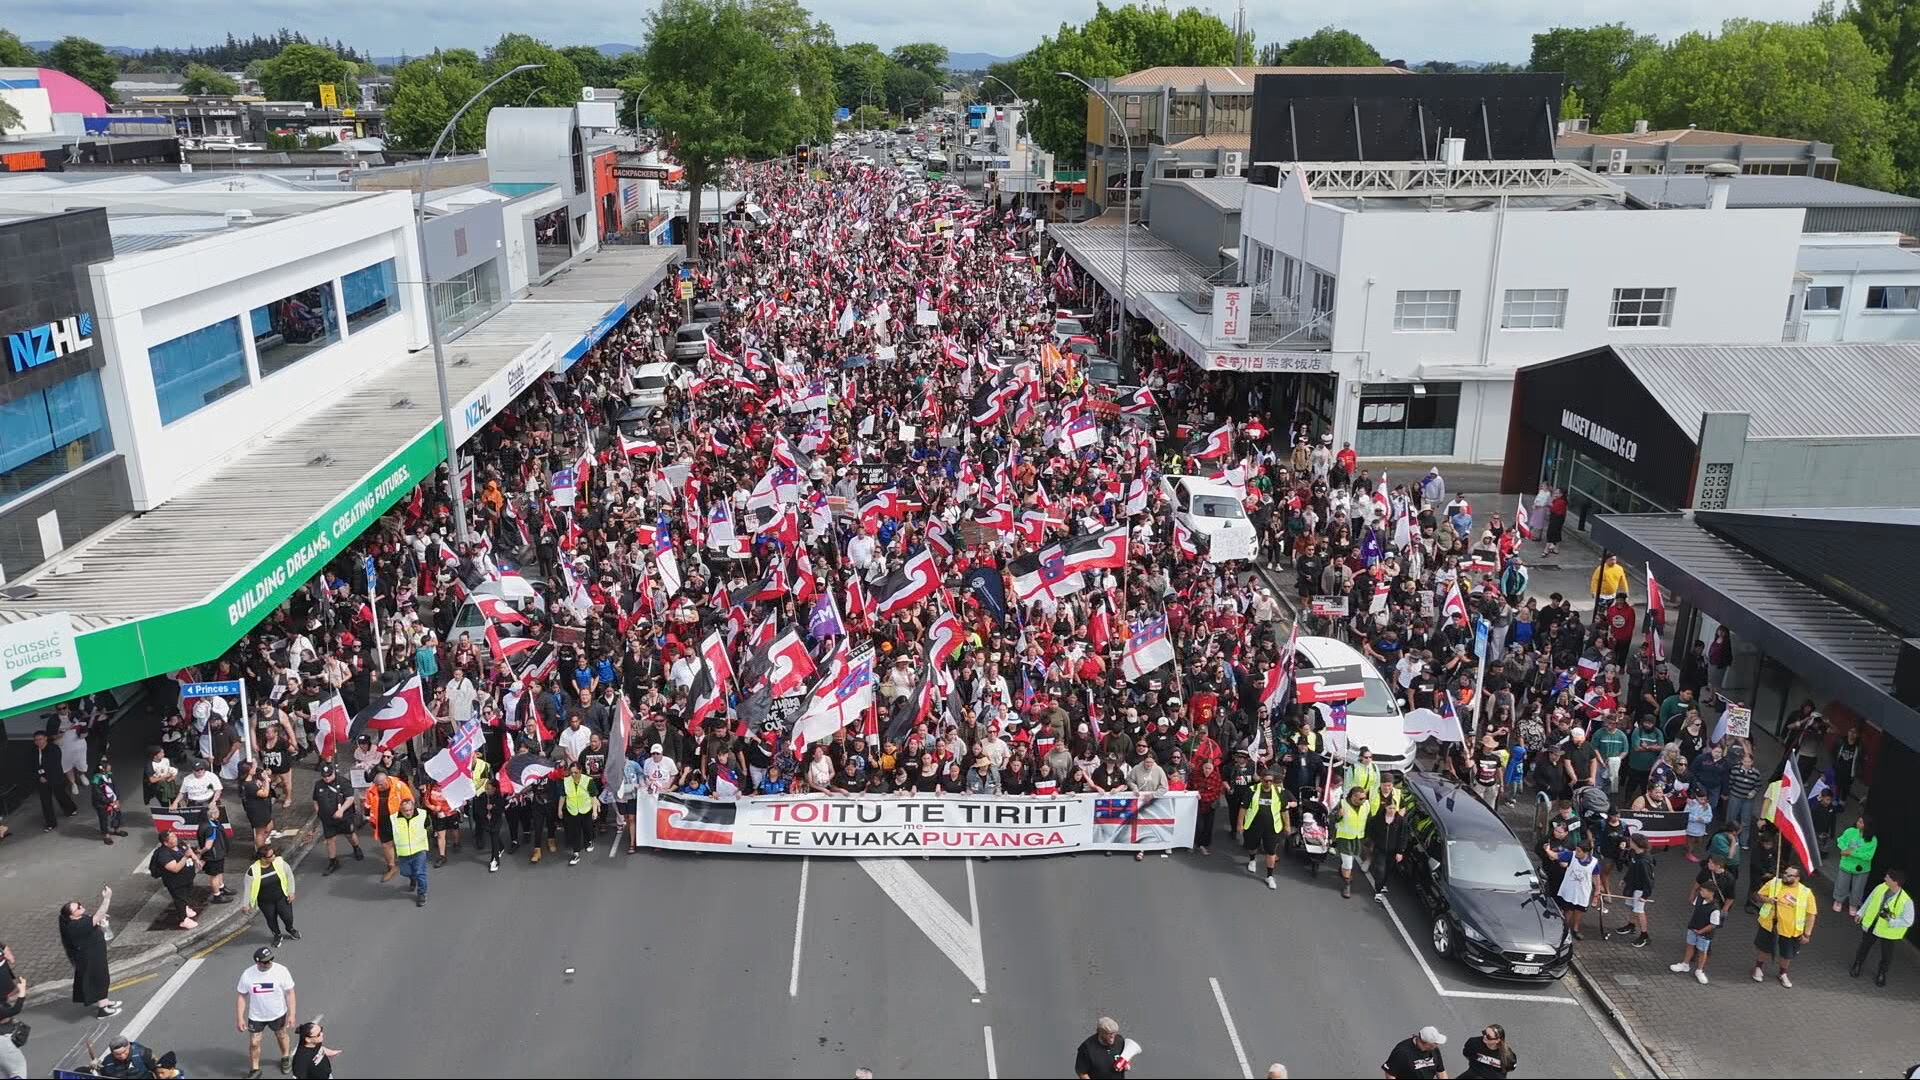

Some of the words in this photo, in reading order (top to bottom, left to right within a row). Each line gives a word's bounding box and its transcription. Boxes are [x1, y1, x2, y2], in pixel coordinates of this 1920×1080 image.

[613, 169, 658, 178] BACKPACKERS
[1224, 292, 1240, 335] 종가집
[8, 315, 93, 373] NZHL
[464, 393, 492, 430] NZHL
[1561, 408, 1590, 438] MAISEY
[1589, 422, 1619, 453] HARRIS
[1618, 437, 1626, 457] &
[228, 566, 286, 626] BUILDING
[285, 531, 331, 578] DREAMS,
[332, 495, 375, 539] CREATING
[374, 464, 411, 503] FUTURES.
[3, 636, 60, 658] classic
[5, 648, 63, 670] builders
[195, 685, 229, 694] Princes
[898, 804, 945, 823] TE
[958, 805, 1066, 824] TIRITI
[767, 830, 801, 845] TE
[811, 832, 1065, 847] WHAKAPUTANGA
